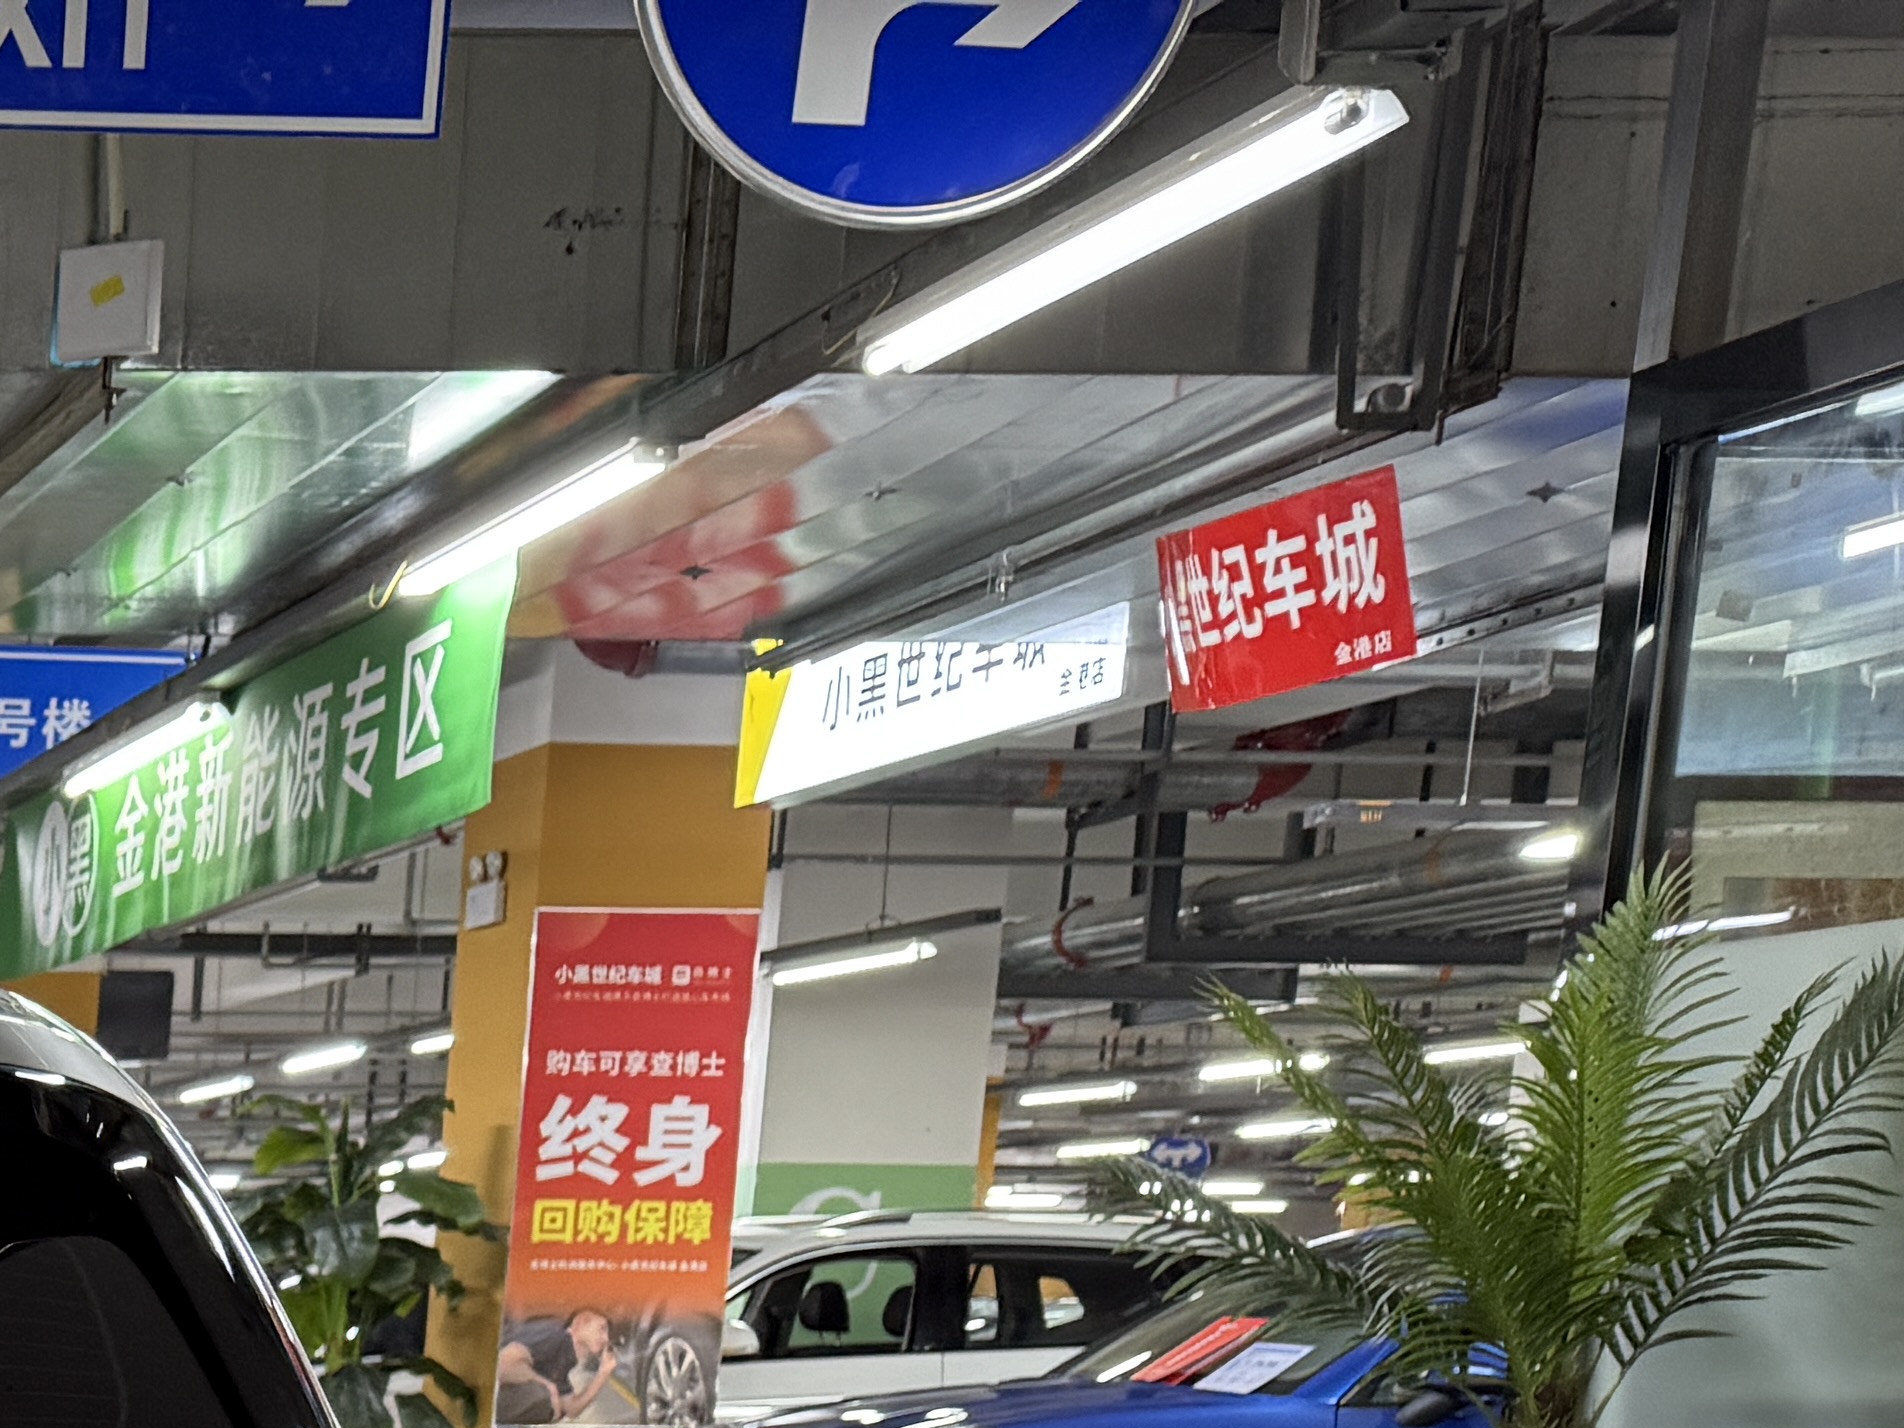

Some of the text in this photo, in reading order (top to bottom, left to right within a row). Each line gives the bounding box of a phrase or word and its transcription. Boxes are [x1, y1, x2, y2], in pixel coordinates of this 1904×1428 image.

[1176, 499, 1386, 652] 世纪车城
[112, 617, 453, 898] 金港新能源专区
[545, 1049, 727, 1078] 购车可享查博士
[535, 1094, 723, 1187] 终身
[530, 1197, 715, 1246] 回购保障
